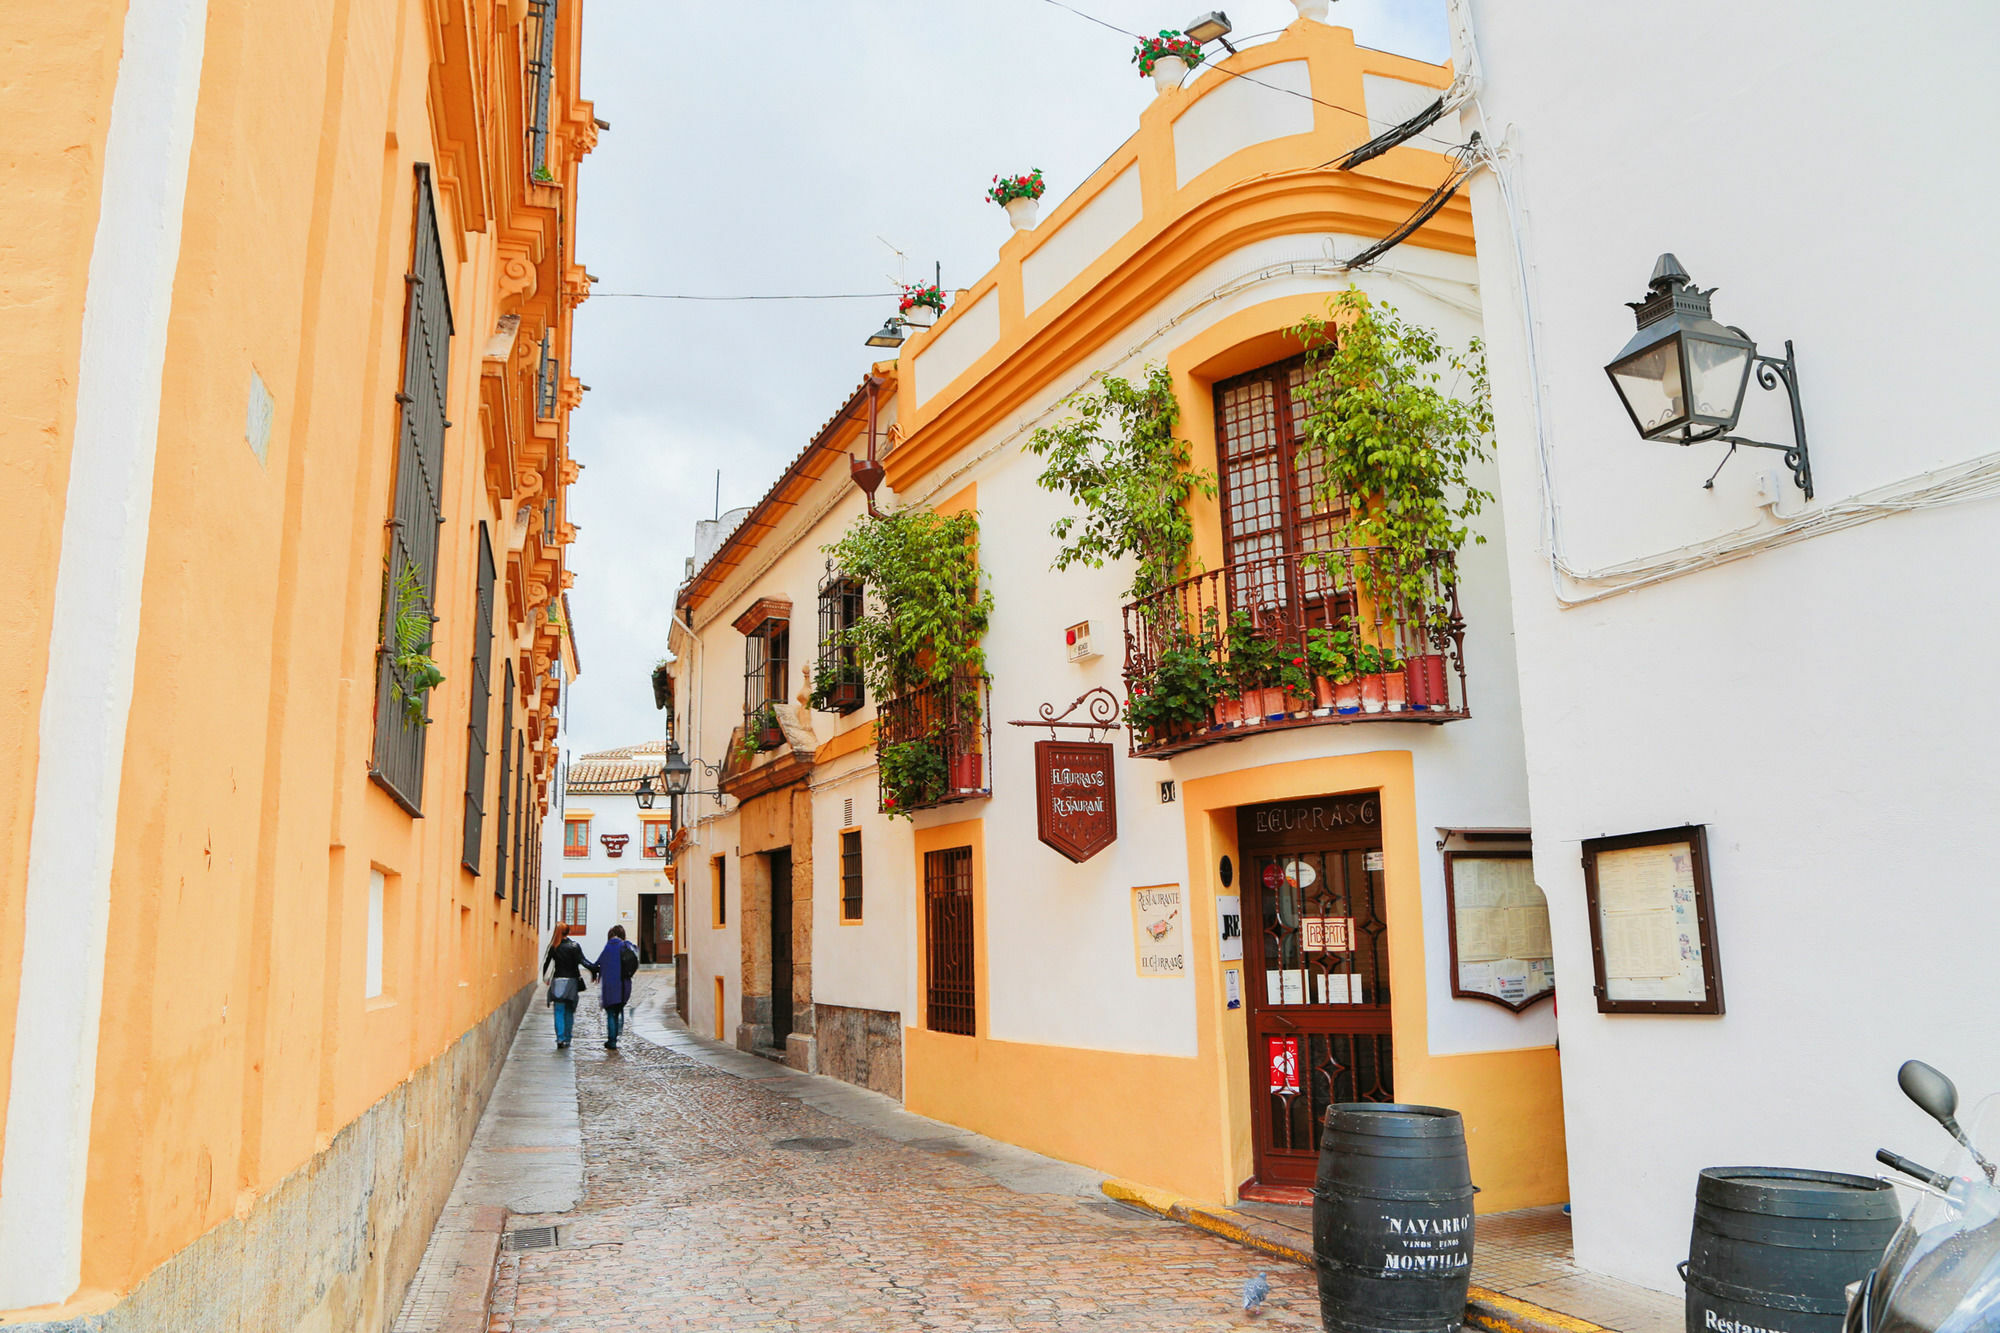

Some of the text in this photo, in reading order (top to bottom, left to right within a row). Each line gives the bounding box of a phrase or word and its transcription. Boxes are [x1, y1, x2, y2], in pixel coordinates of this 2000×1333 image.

[1310, 925, 1346, 943] ABERTO
[1402, 1240, 1431, 1249] VINOS
[1384, 1252, 1468, 1271] MONTILLA
